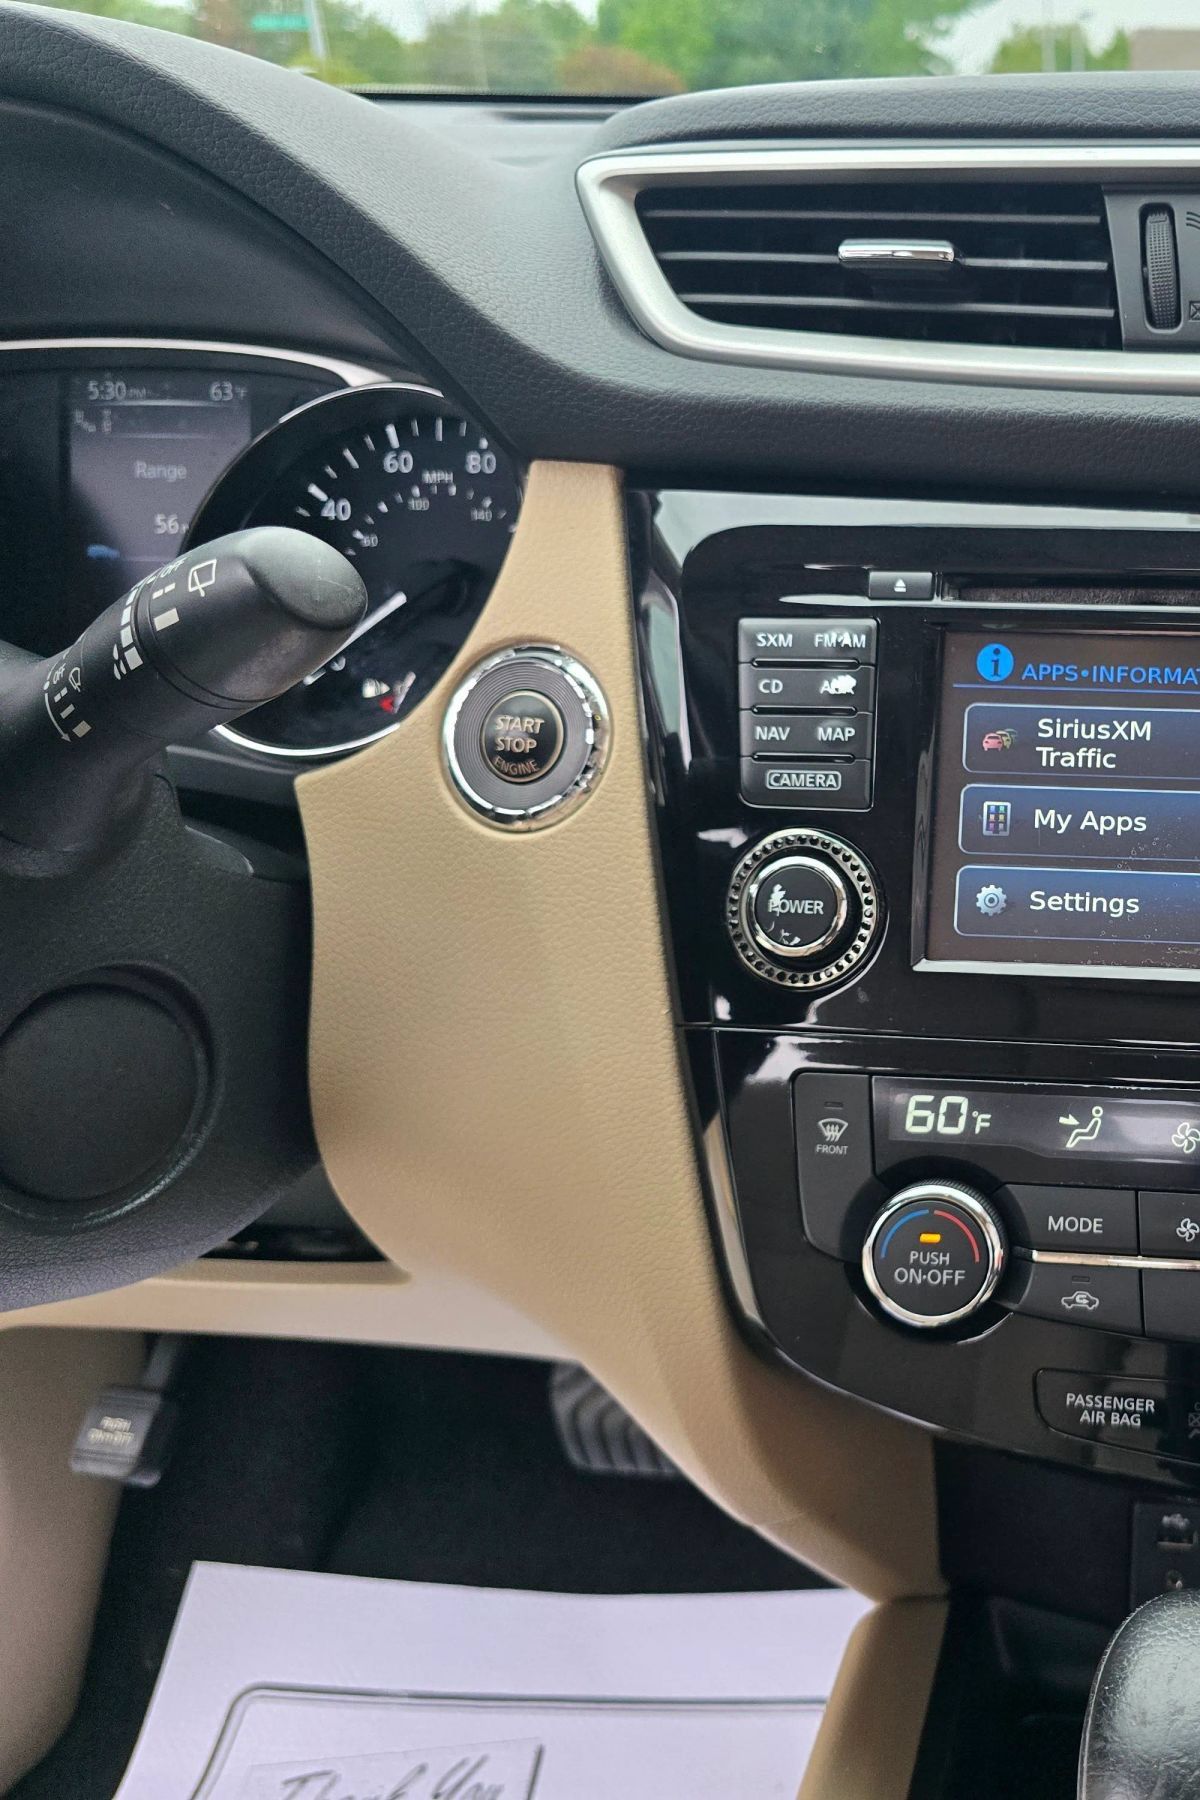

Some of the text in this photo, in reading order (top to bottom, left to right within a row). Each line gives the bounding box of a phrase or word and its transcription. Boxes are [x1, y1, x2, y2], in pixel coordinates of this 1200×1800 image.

[88, 381, 127, 400] 5:30
[134, 461, 188, 482] Range
[383, 451, 414, 474] 60
[465, 451, 497, 474] 80
[421, 470, 454, 484] MPH
[320, 498, 352, 521] 40
[154, 514, 180, 534] 56
[756, 633, 793, 648] SXM
[759, 679, 784, 694] CD
[495, 715, 544, 734] START
[1037, 719, 1152, 741] SiriusXM
[755, 726, 790, 742] NAV
[817, 726, 856, 742] MAP
[495, 737, 537, 753] STOP
[494, 757, 539, 775] ENGINE
[1035, 746, 1117, 769] Traffic
[770, 772, 838, 788] CAMERA
[1033, 809, 1147, 835] My Apps
[768, 900, 824, 915] POWER
[1029, 891, 1140, 916] Settings
[816, 1144, 848, 1155] FRONT
[1047, 1216, 1103, 1233] MODE
[909, 1251, 950, 1266] PUSH
[1065, 1392, 1155, 1413] PASSENGER
[1079, 1411, 1141, 1427] AIR BAG
